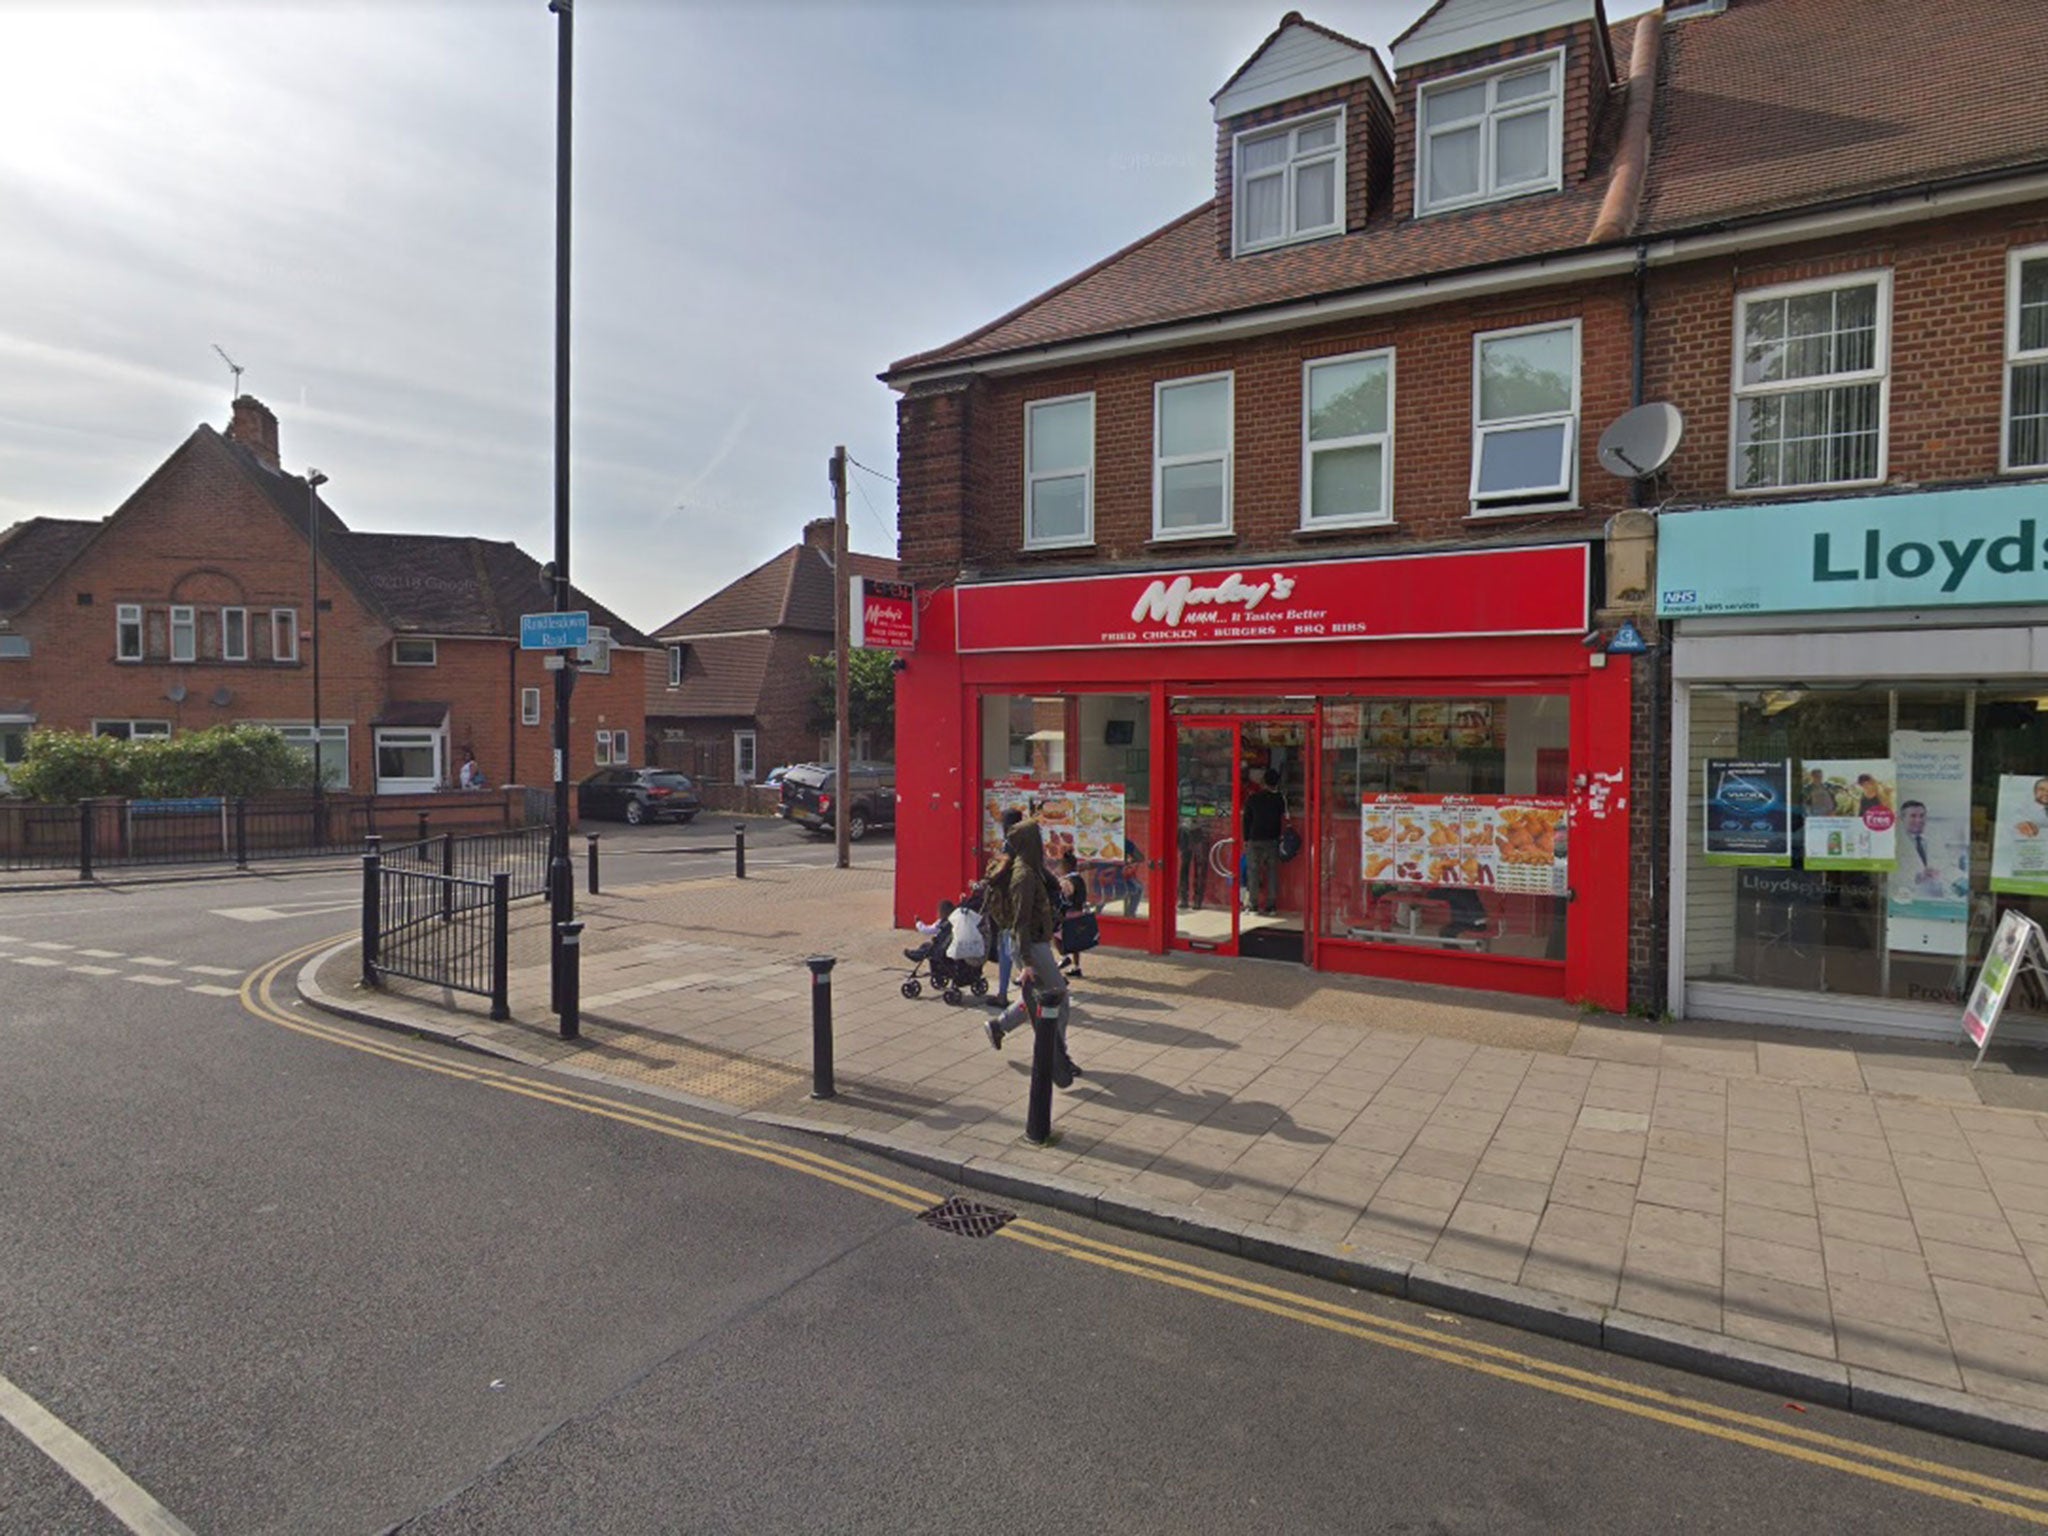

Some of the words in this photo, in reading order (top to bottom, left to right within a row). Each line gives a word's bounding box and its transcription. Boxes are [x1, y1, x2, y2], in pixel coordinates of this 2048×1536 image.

[1813, 519, 2048, 592] Lloyd
[1131, 572, 1295, 627] Morley's
[1664, 591, 1695, 603] NHS
[1244, 611, 1285, 622] Tastes
[1286, 609, 1328, 620] Better
[542, 631, 567, 646] Road
[1101, 632, 1137, 641] FRIED
[1142, 629, 1198, 640] CHICKEN
[1214, 625, 1277, 637] BURGERS
[1294, 623, 1326, 635] BBQ
[1331, 621, 1367, 633] RIBS
